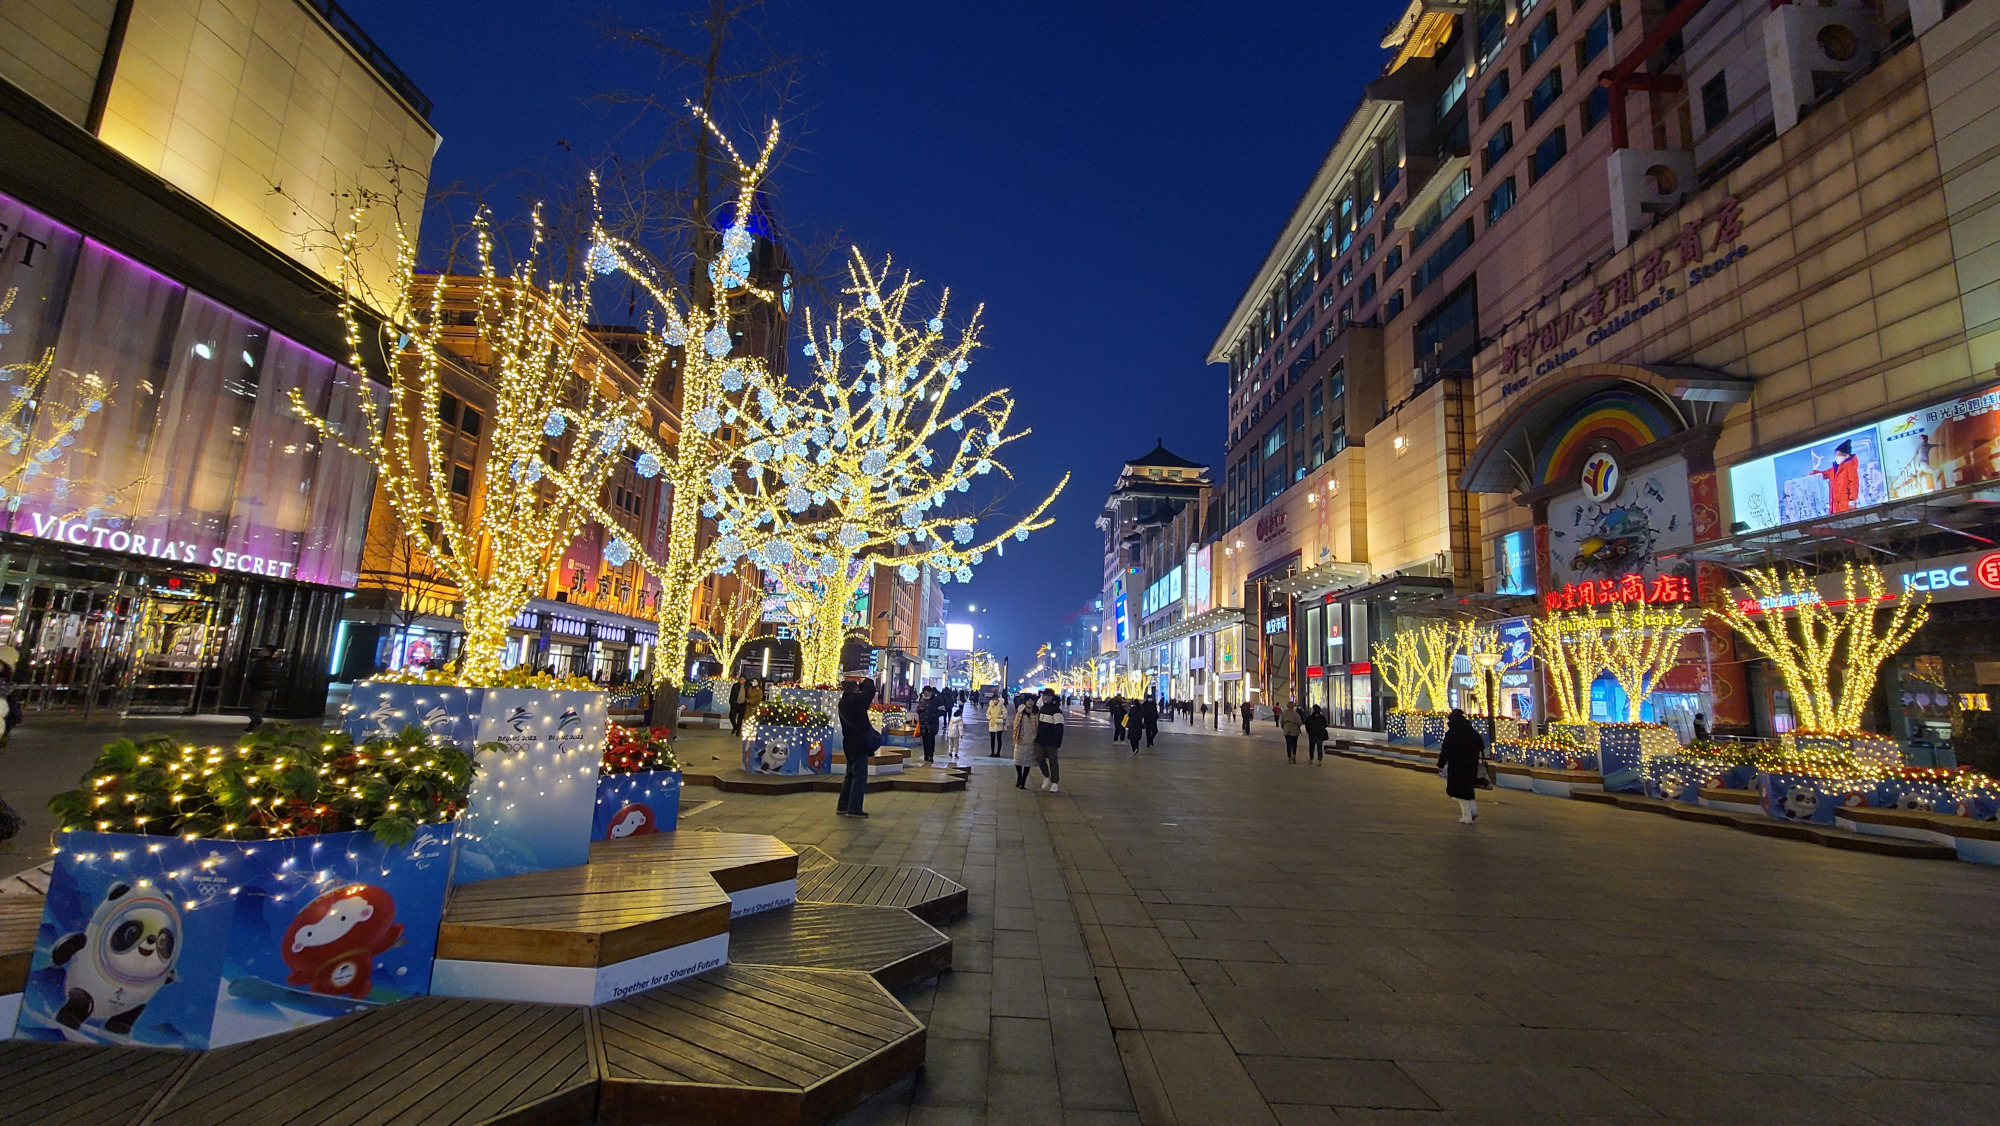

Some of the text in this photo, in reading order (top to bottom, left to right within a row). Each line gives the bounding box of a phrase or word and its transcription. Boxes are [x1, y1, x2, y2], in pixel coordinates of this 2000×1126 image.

[1501, 243, 1749, 397] New China Children's Store
[30, 513, 292, 578] VICTORIA'S SECRET
[1902, 565, 1970, 592] ICBC
[1632, 613, 1684, 627] Store
[743, 906, 751, 915] for
[757, 899, 775, 912] Shared
[774, 896, 791, 908] Future
[613, 957, 721, 998] Together for a Shared Future
